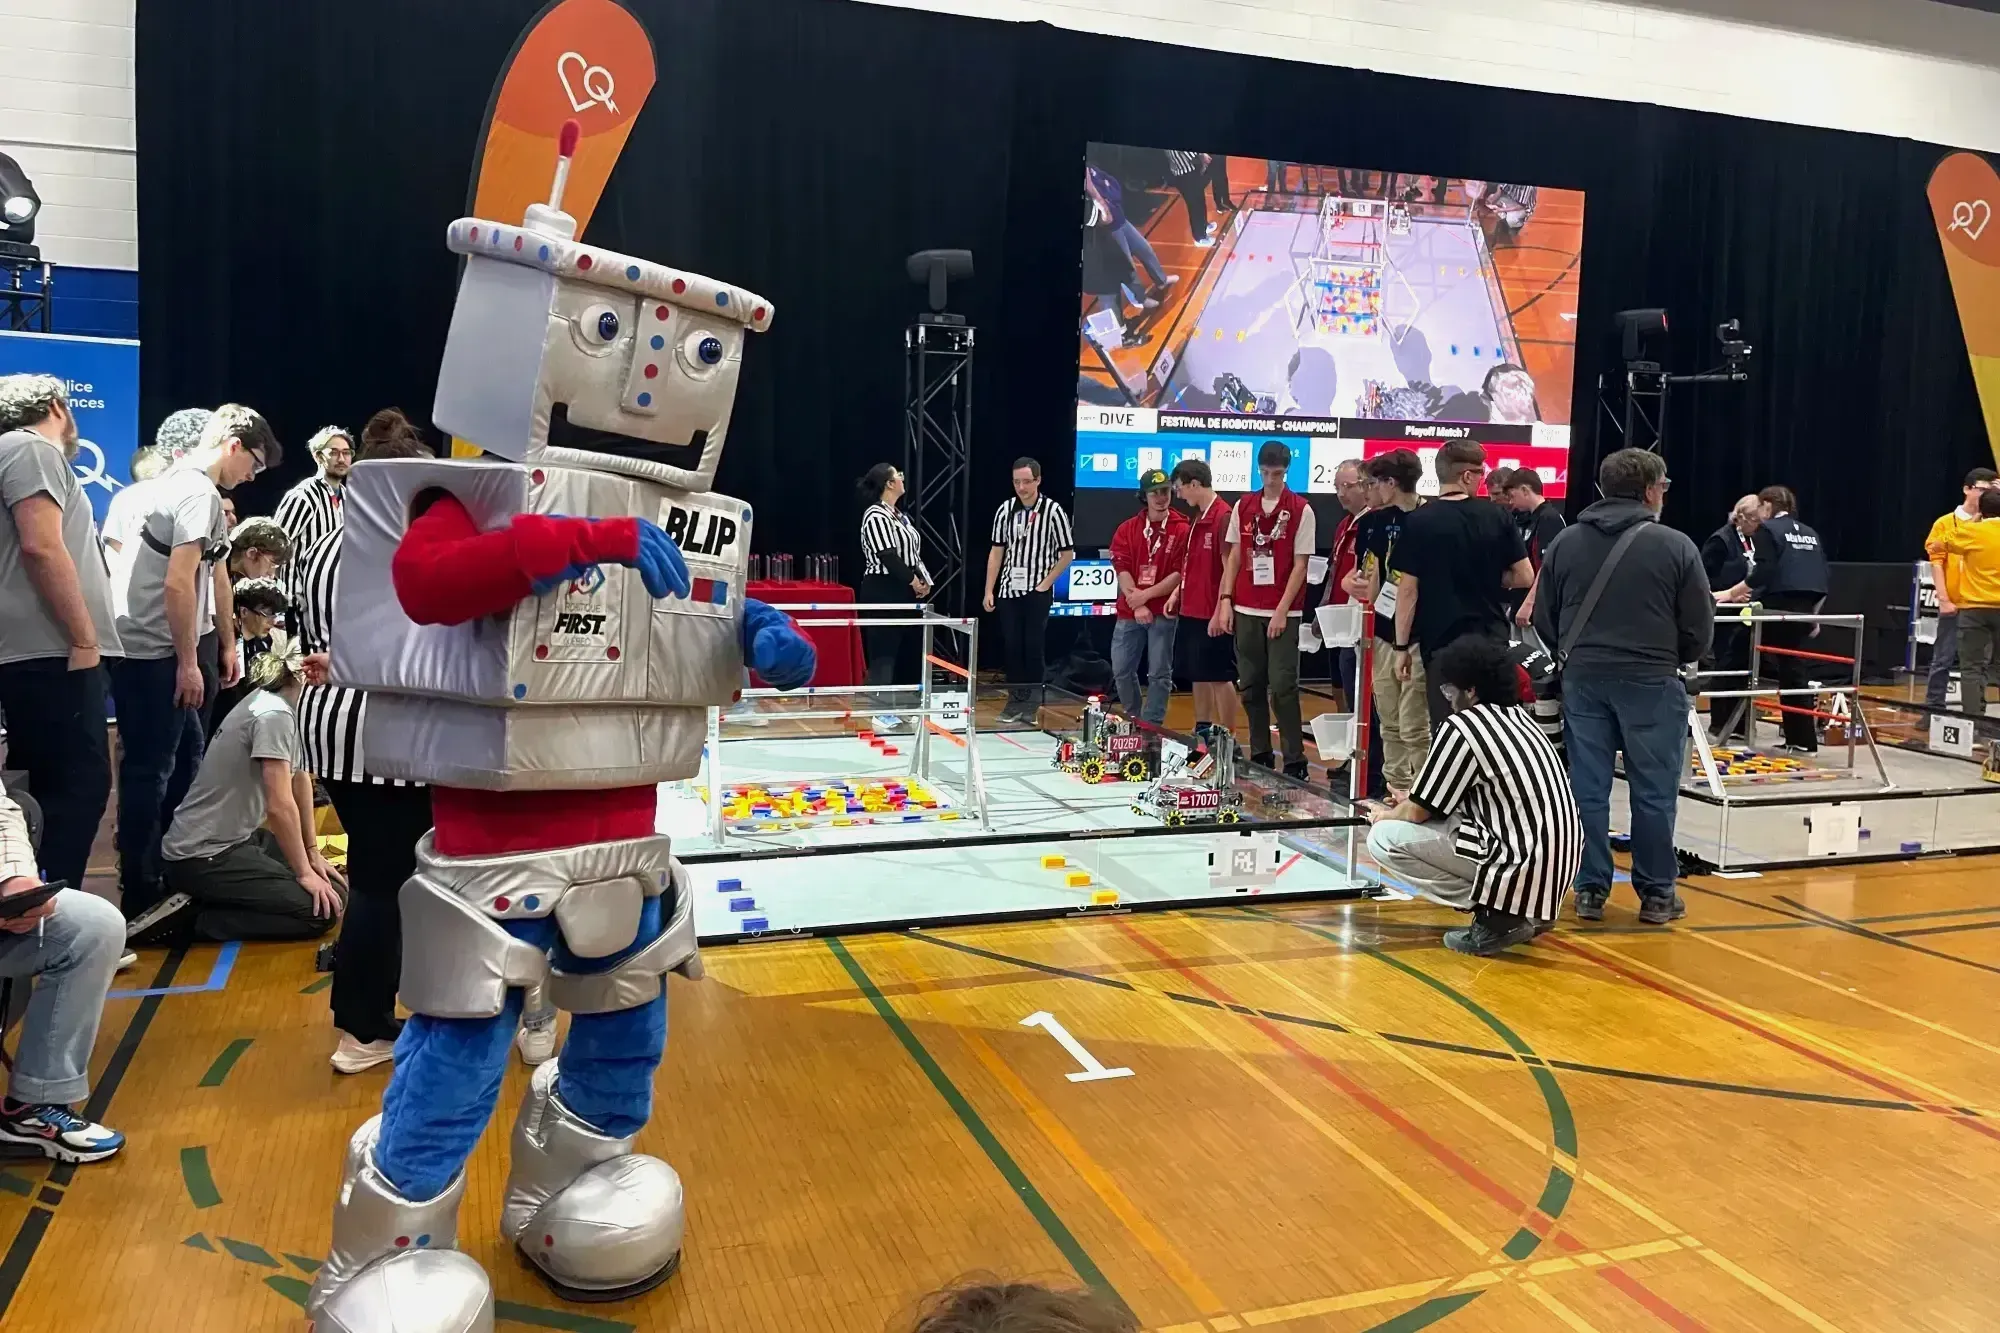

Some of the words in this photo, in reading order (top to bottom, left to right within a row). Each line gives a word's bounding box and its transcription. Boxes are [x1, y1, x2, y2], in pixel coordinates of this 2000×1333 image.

[65, 379, 93, 393] lice
[67, 397, 105, 409] nces
[1100, 412, 1135, 427] DIVE
[1160, 415, 1206, 429] FESTIVAL
[1207, 417, 1221, 429] DE
[1221, 418, 1276, 431] ROBOTIQUE
[1405, 425, 1436, 438] Playoff
[1436, 426, 1463, 438] Match
[1463, 427, 1471, 438] 7
[665, 506, 737, 557] BLIP
[1073, 569, 1115, 586] 2:30
[553, 612, 607, 636] FIRST
[1112, 737, 1140, 750] 20267
[1190, 793, 1219, 807] 17070
